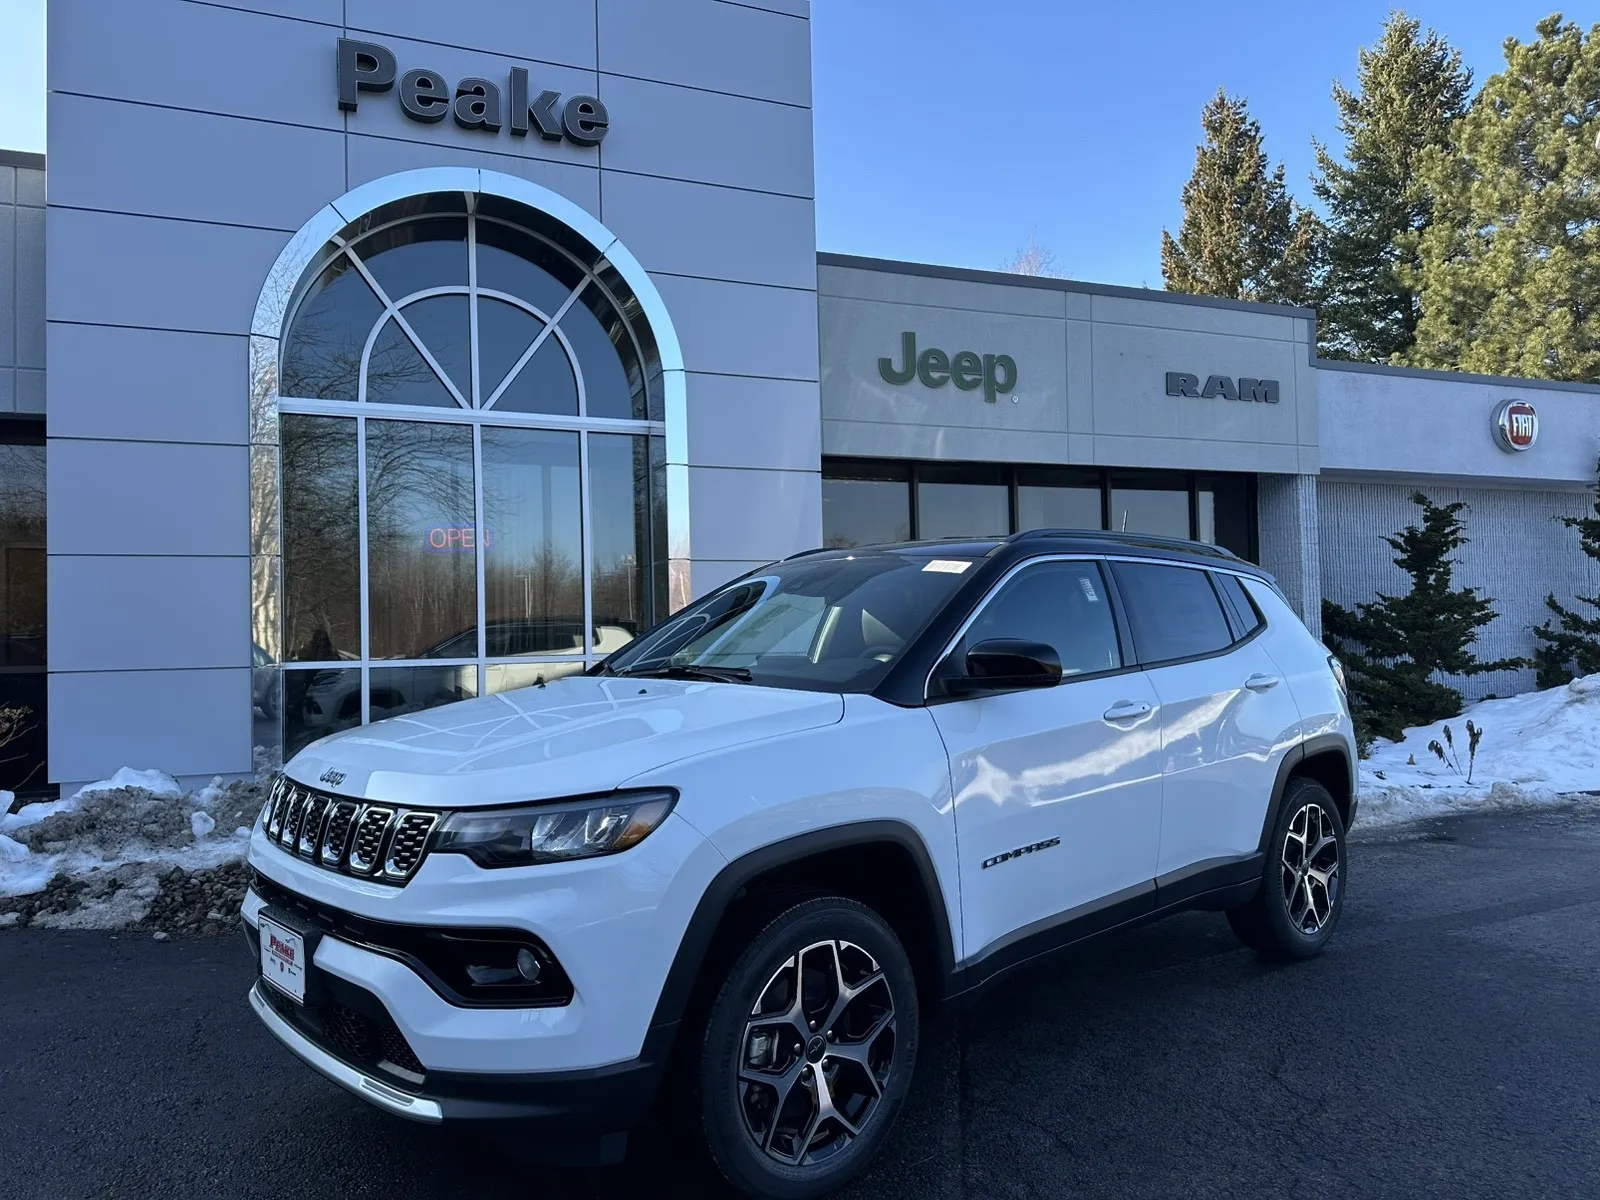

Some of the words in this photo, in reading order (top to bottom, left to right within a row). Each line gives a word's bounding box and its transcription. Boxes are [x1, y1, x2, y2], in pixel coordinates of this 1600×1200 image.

[337, 37, 609, 146] Peake
[878, 331, 1018, 403] Jeep
[1165, 371, 1280, 403] RAM
[1511, 413, 1533, 437] FIAT
[319, 766, 347, 789] Jeep
[981, 835, 1061, 870] COMPASS
